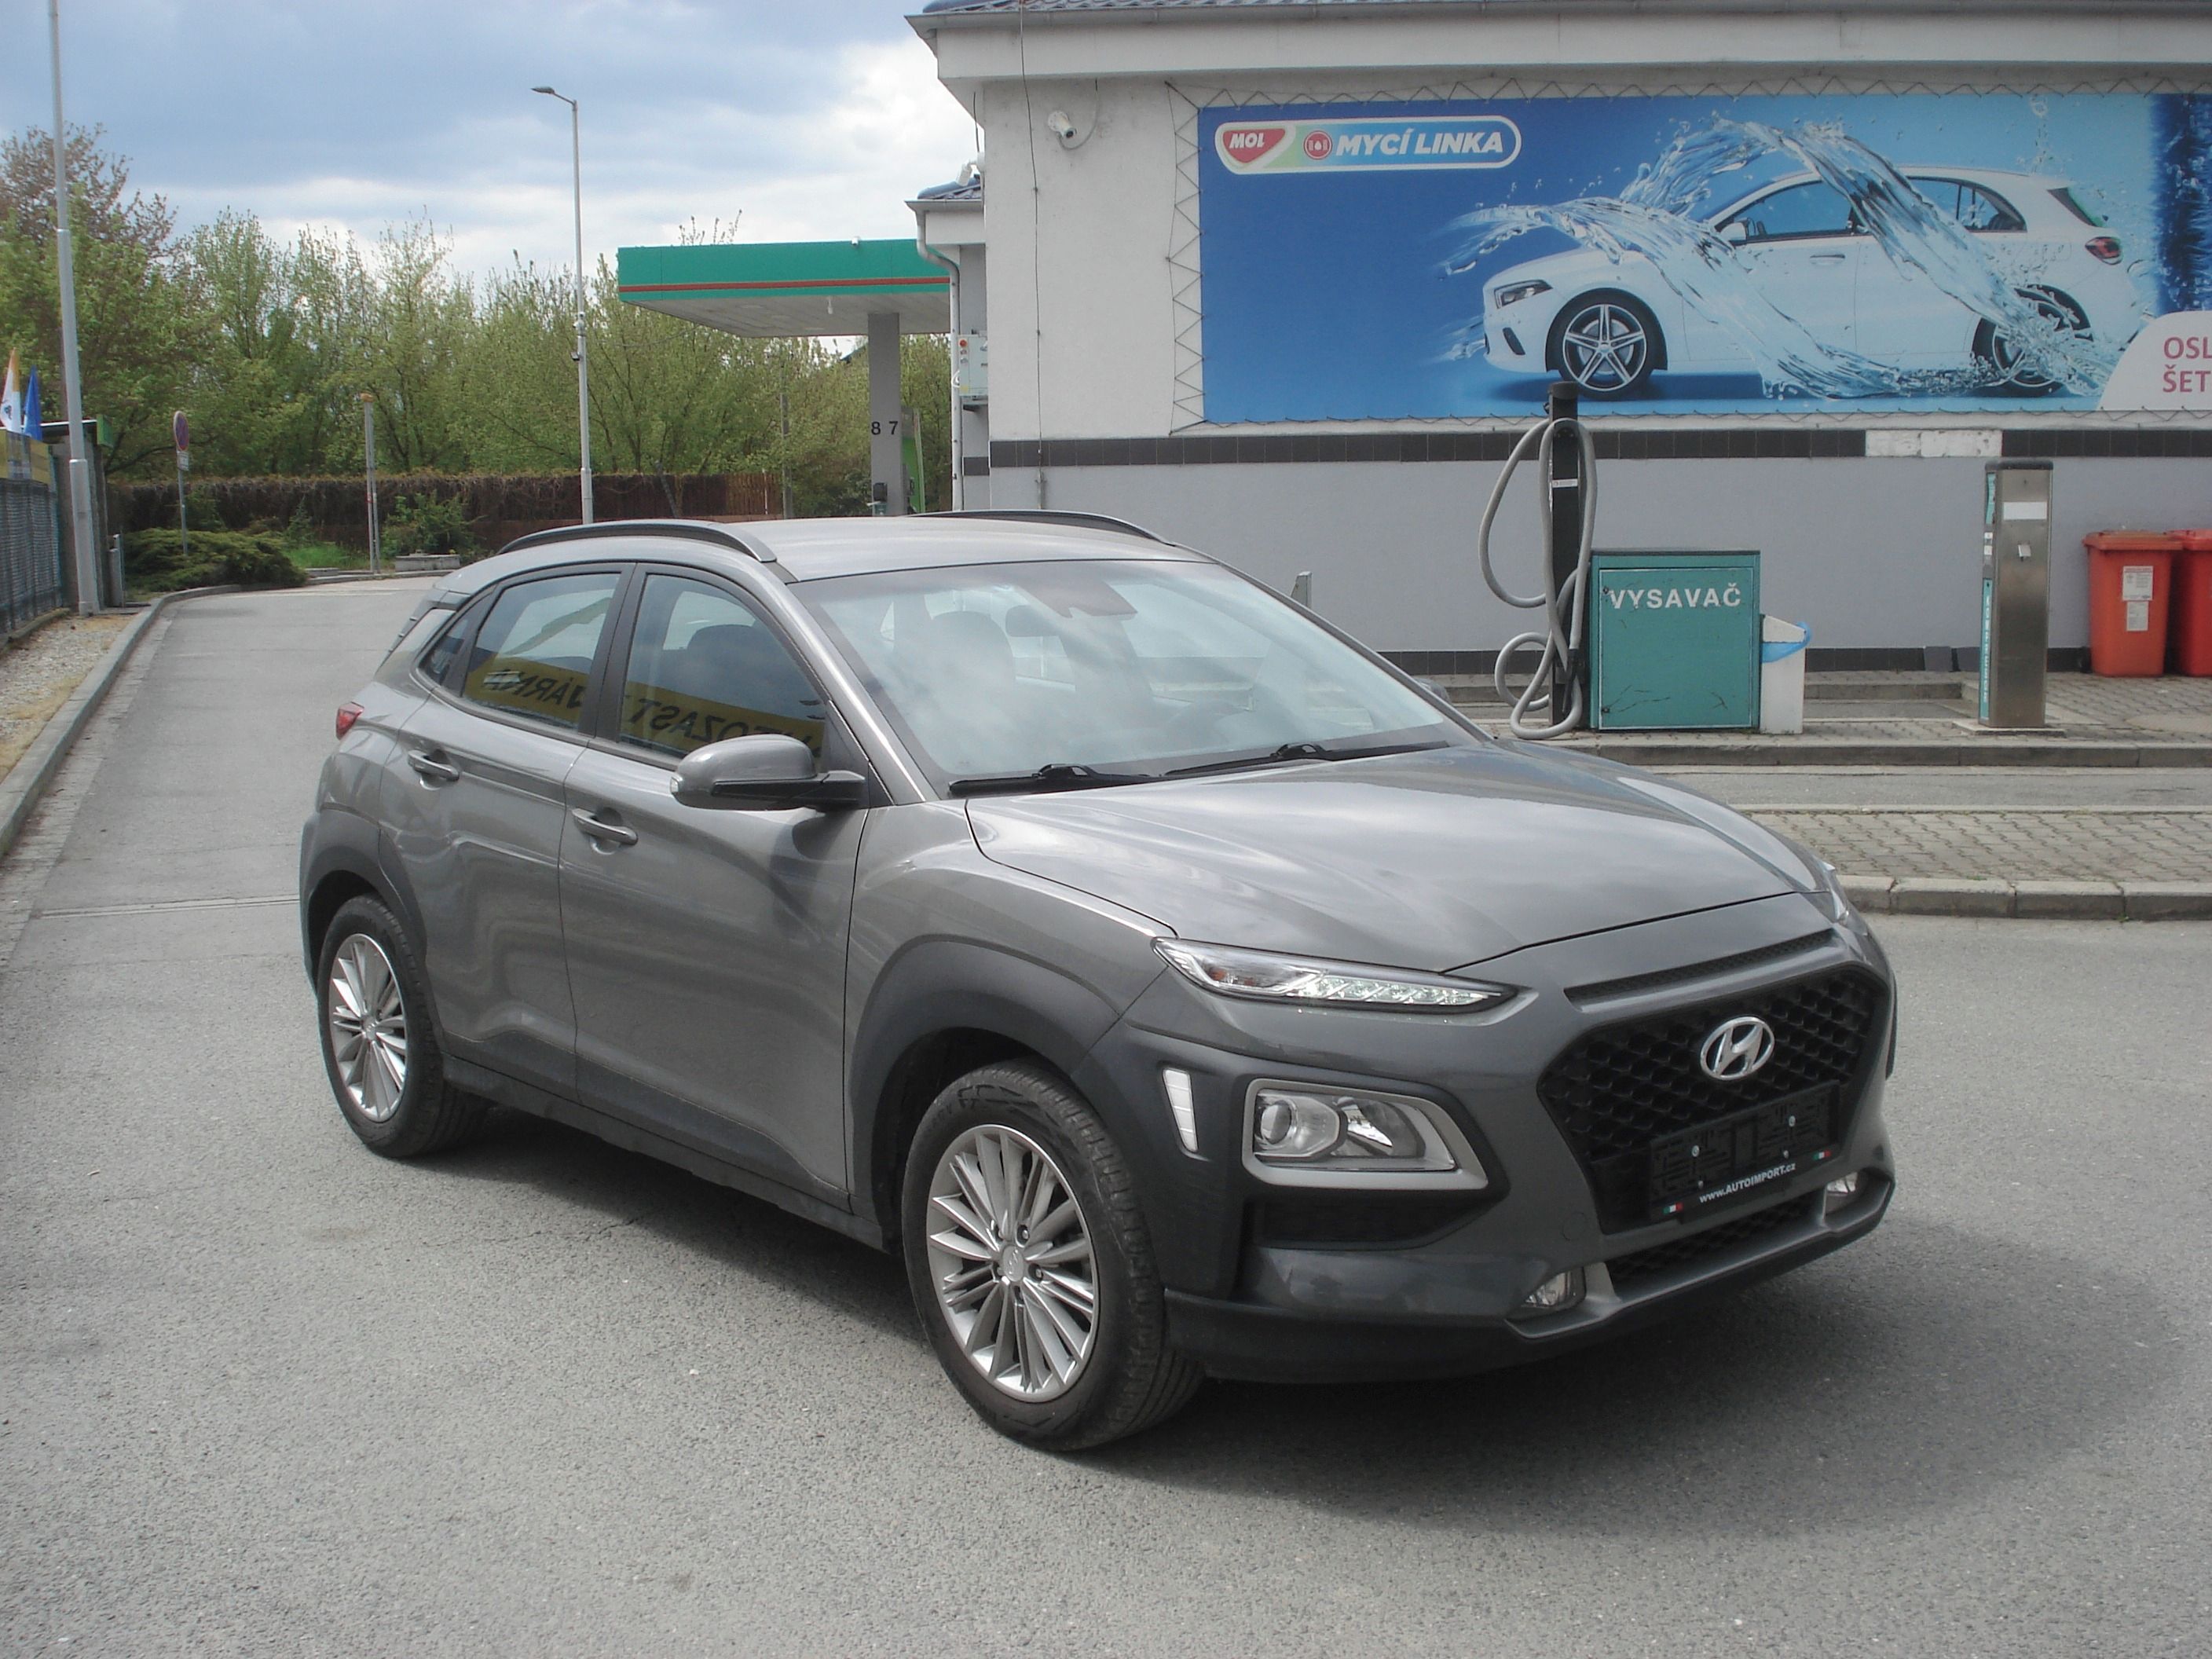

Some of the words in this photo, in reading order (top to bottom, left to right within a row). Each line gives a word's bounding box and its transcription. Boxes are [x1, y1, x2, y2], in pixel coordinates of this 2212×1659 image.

[1229, 132, 1265, 149] MOL
[1336, 127, 1414, 156] MYCÍ
[1415, 132, 1503, 155] LINKA
[2163, 364, 2211, 393] ŠET
[871, 421, 881, 435] 8
[889, 420, 899, 435] 7
[1609, 582, 1741, 610] VYSAVAČ
[1699, 1163, 1796, 1203] www.AUTOIMPORT.cz
